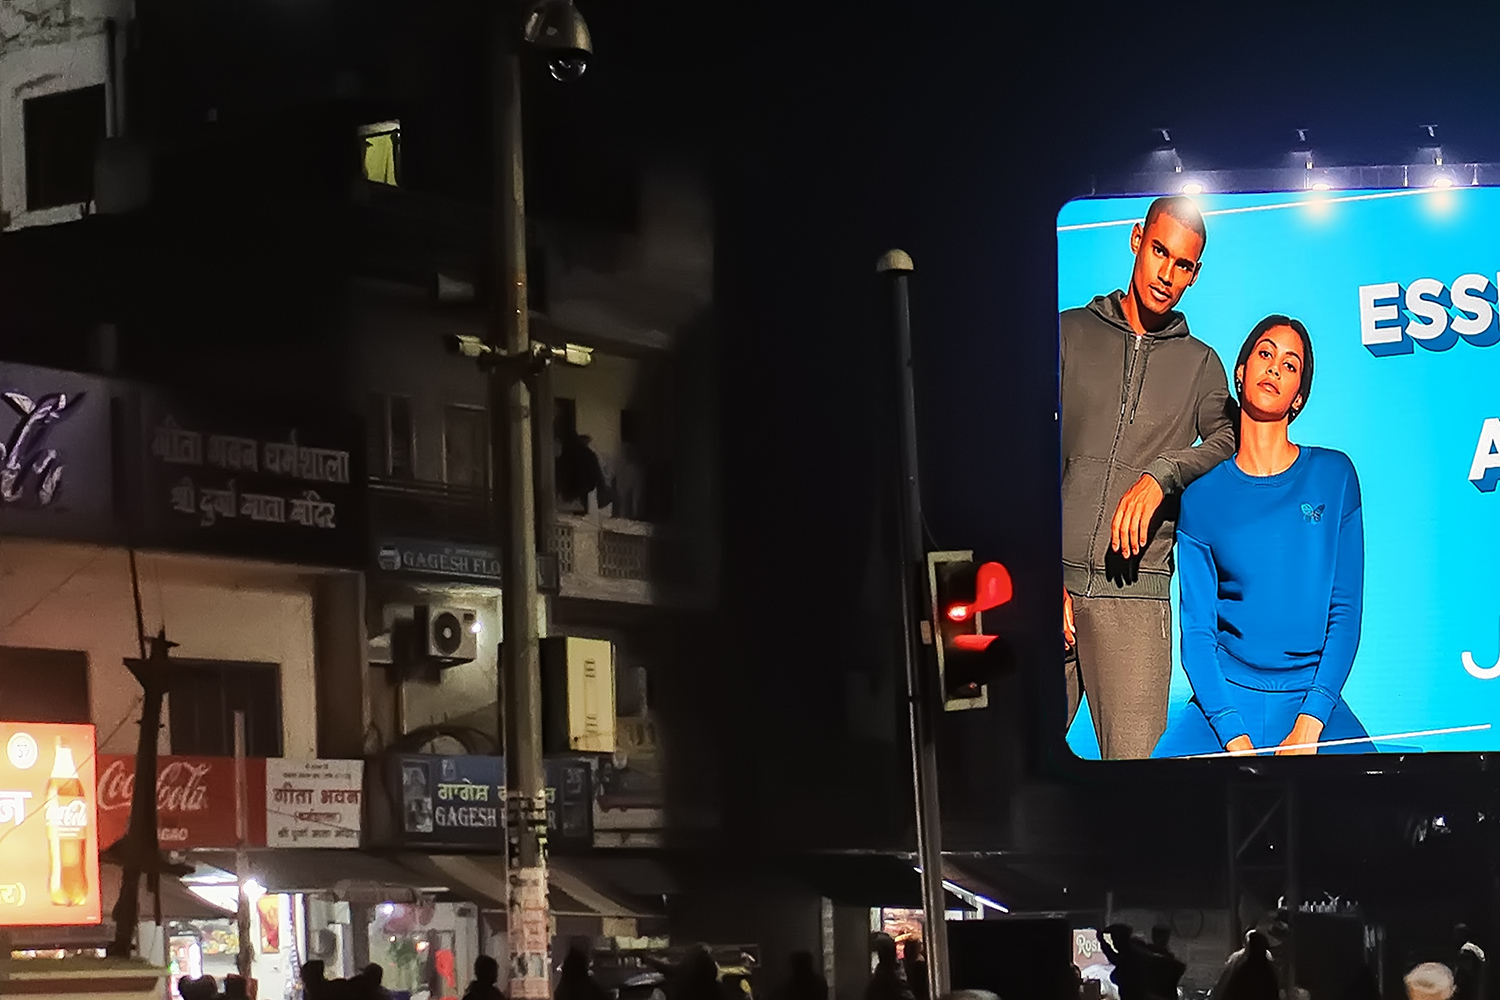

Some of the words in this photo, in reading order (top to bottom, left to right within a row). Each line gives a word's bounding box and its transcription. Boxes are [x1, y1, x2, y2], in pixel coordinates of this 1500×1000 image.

[403, 551, 470, 572] GAGESH
[473, 557, 501, 575] FLO
[272, 782, 314, 805] गीता
[320, 789, 361, 805] भवन
[435, 806, 497, 827] GAGESH
